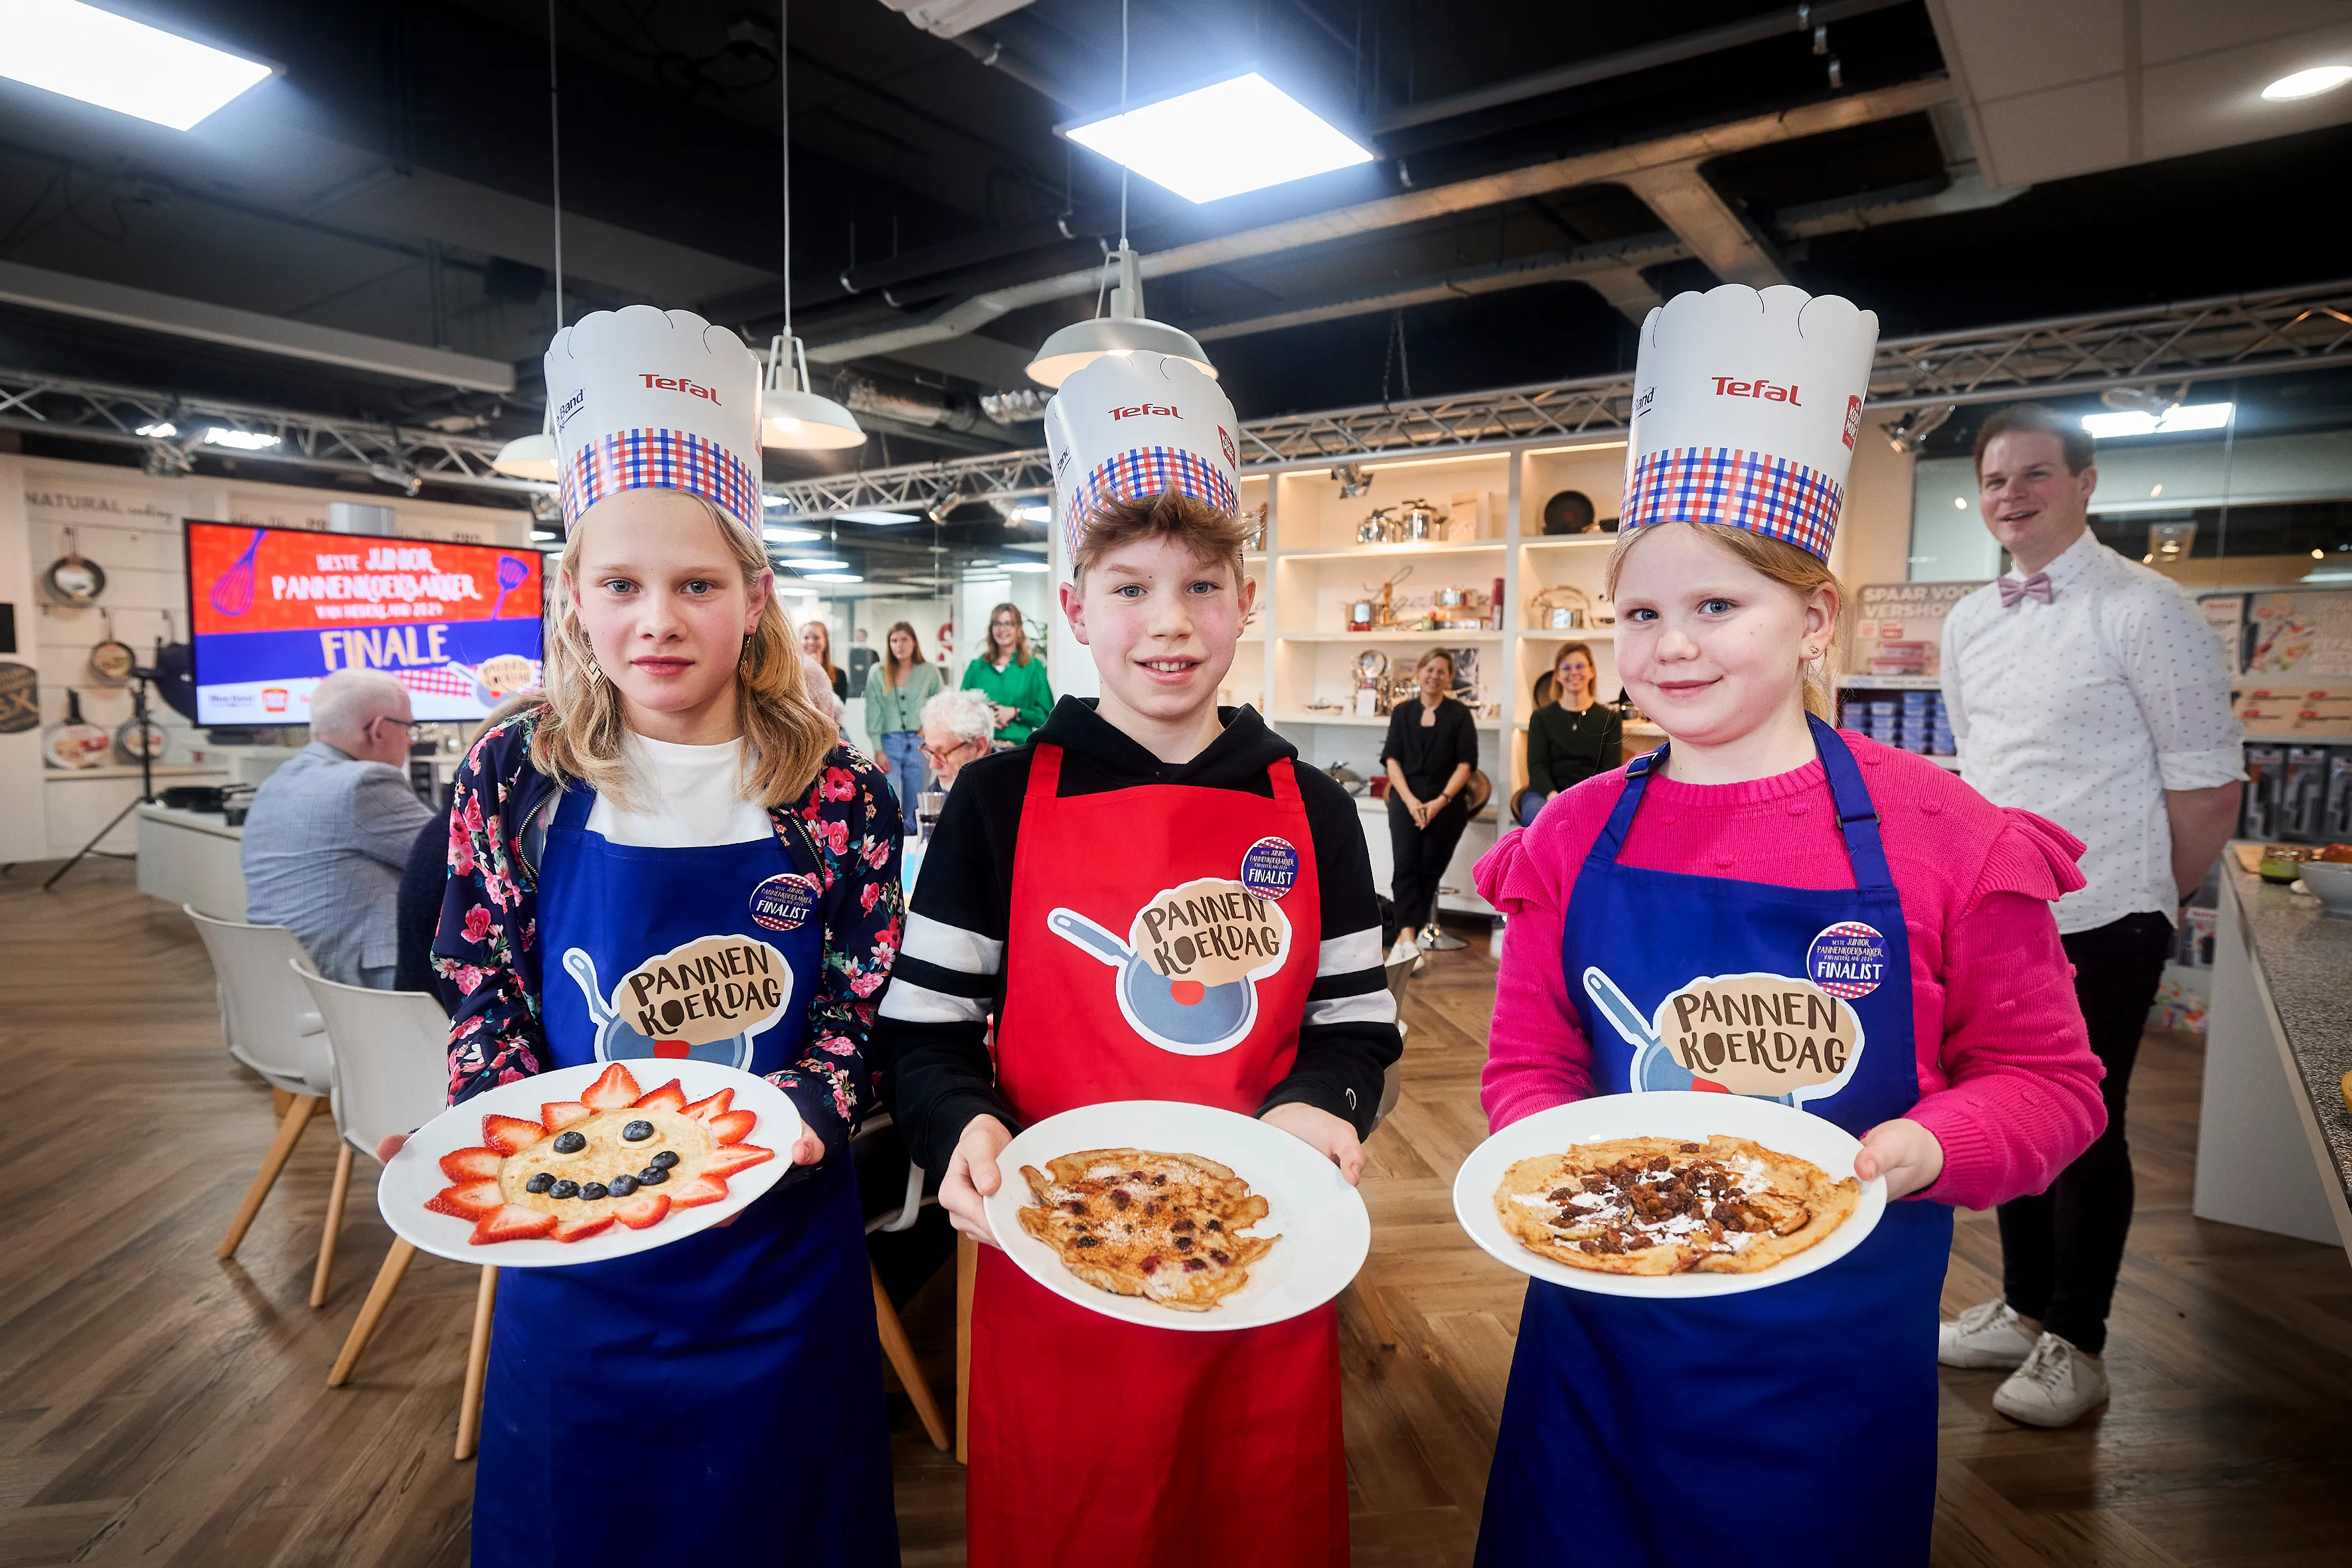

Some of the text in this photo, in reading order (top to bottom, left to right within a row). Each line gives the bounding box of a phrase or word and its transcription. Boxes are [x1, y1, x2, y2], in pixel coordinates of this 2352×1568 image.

[639, 374, 722, 406] Tefal
[1711, 376, 1802, 407] Tefal
[1108, 404, 1184, 421] Tefal
[1864, 586, 1928, 603] SPAAR
[319, 624, 451, 672] FINALE
[1248, 868, 1294, 885] FINALIST
[761, 888, 813, 905] PANNENKOEKBAKKER
[787, 886, 805, 896] JUNIOR
[755, 900, 811, 920] FINALIST
[1142, 892, 1267, 944] PANNEN
[1154, 924, 1280, 976] KOEKDAG
[1817, 945, 1884, 957] PANNENKOEKBAKKER
[1847, 938, 1871, 947] JUNIOR
[628, 945, 769, 1007] PANNEN
[1817, 961, 1884, 980] FINALIST
[638, 978, 781, 1037] KOEKDAG
[1673, 990, 1837, 1033] PANNEN
[1680, 1028, 1847, 1074] KOEKDAG
